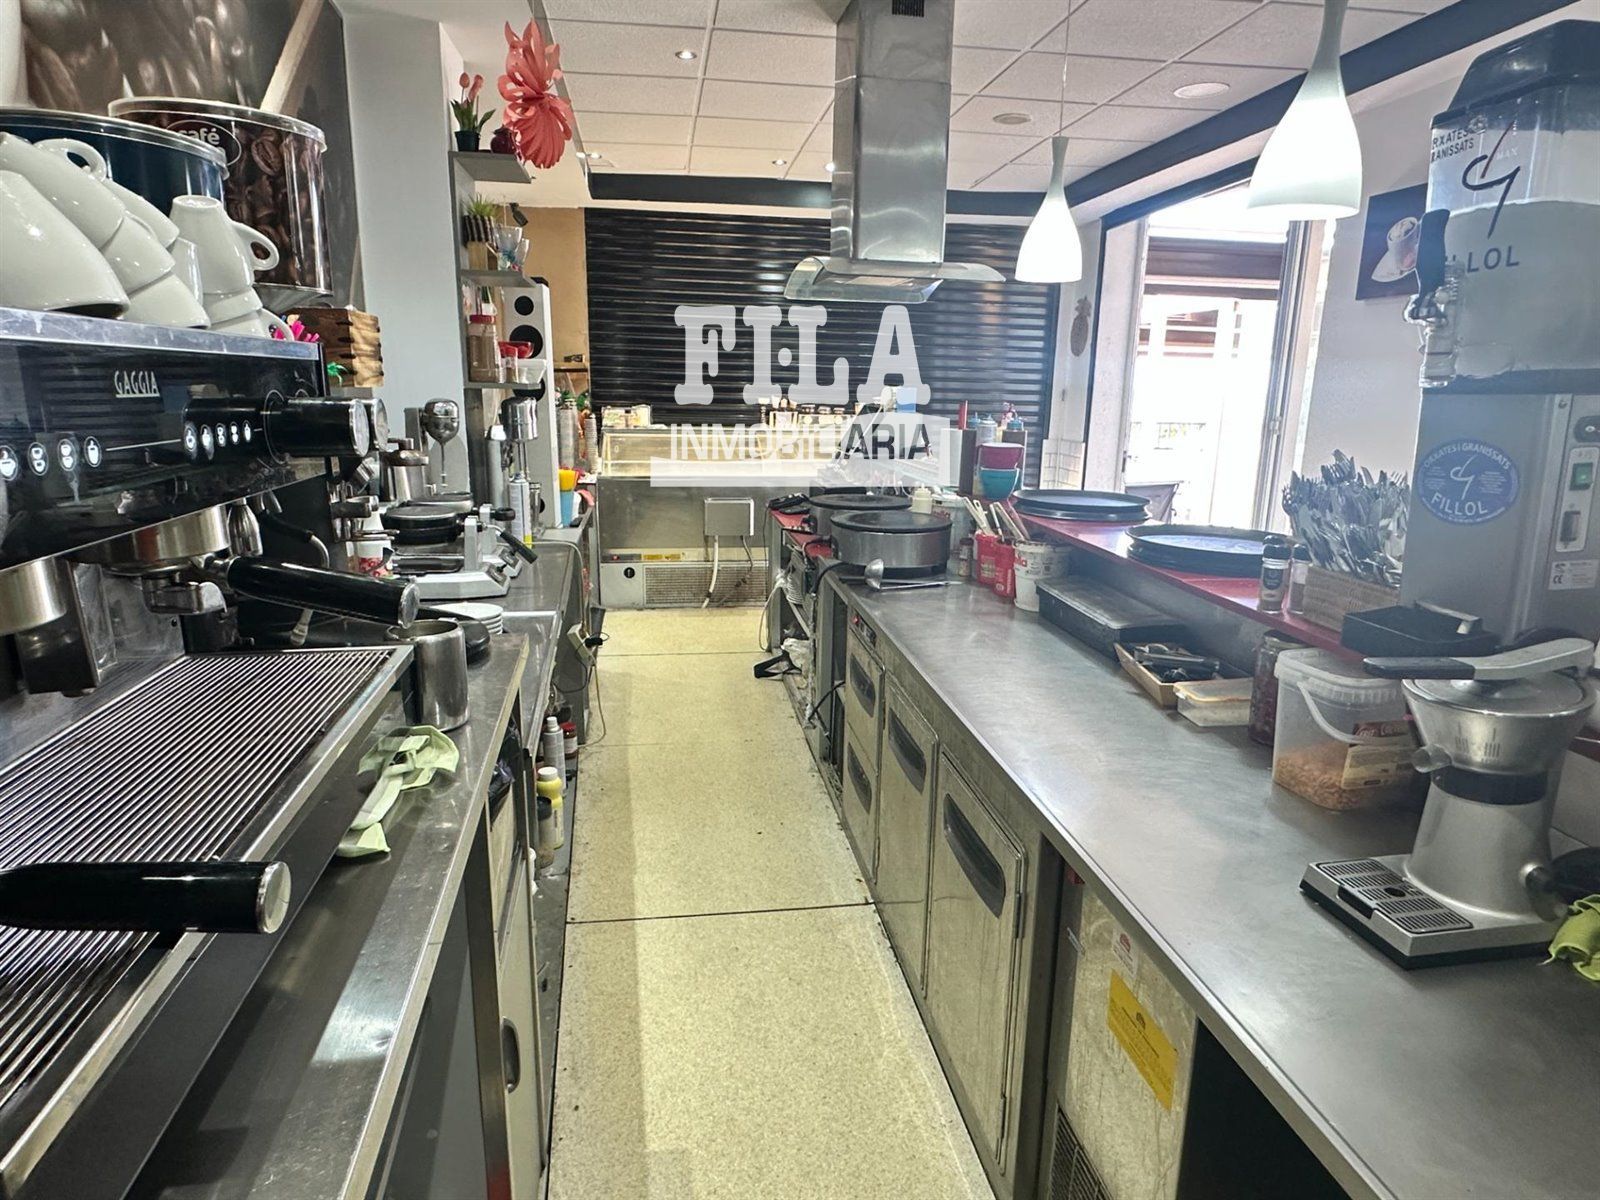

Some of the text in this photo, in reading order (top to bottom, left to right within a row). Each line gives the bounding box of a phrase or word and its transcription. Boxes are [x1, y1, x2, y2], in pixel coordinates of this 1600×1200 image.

[1444, 246, 1520, 273] LOL
[114, 370, 160, 397] GAGGIA
[1461, 442, 1512, 470] GRANISSATS
[1431, 491, 1488, 516] FILLOL
